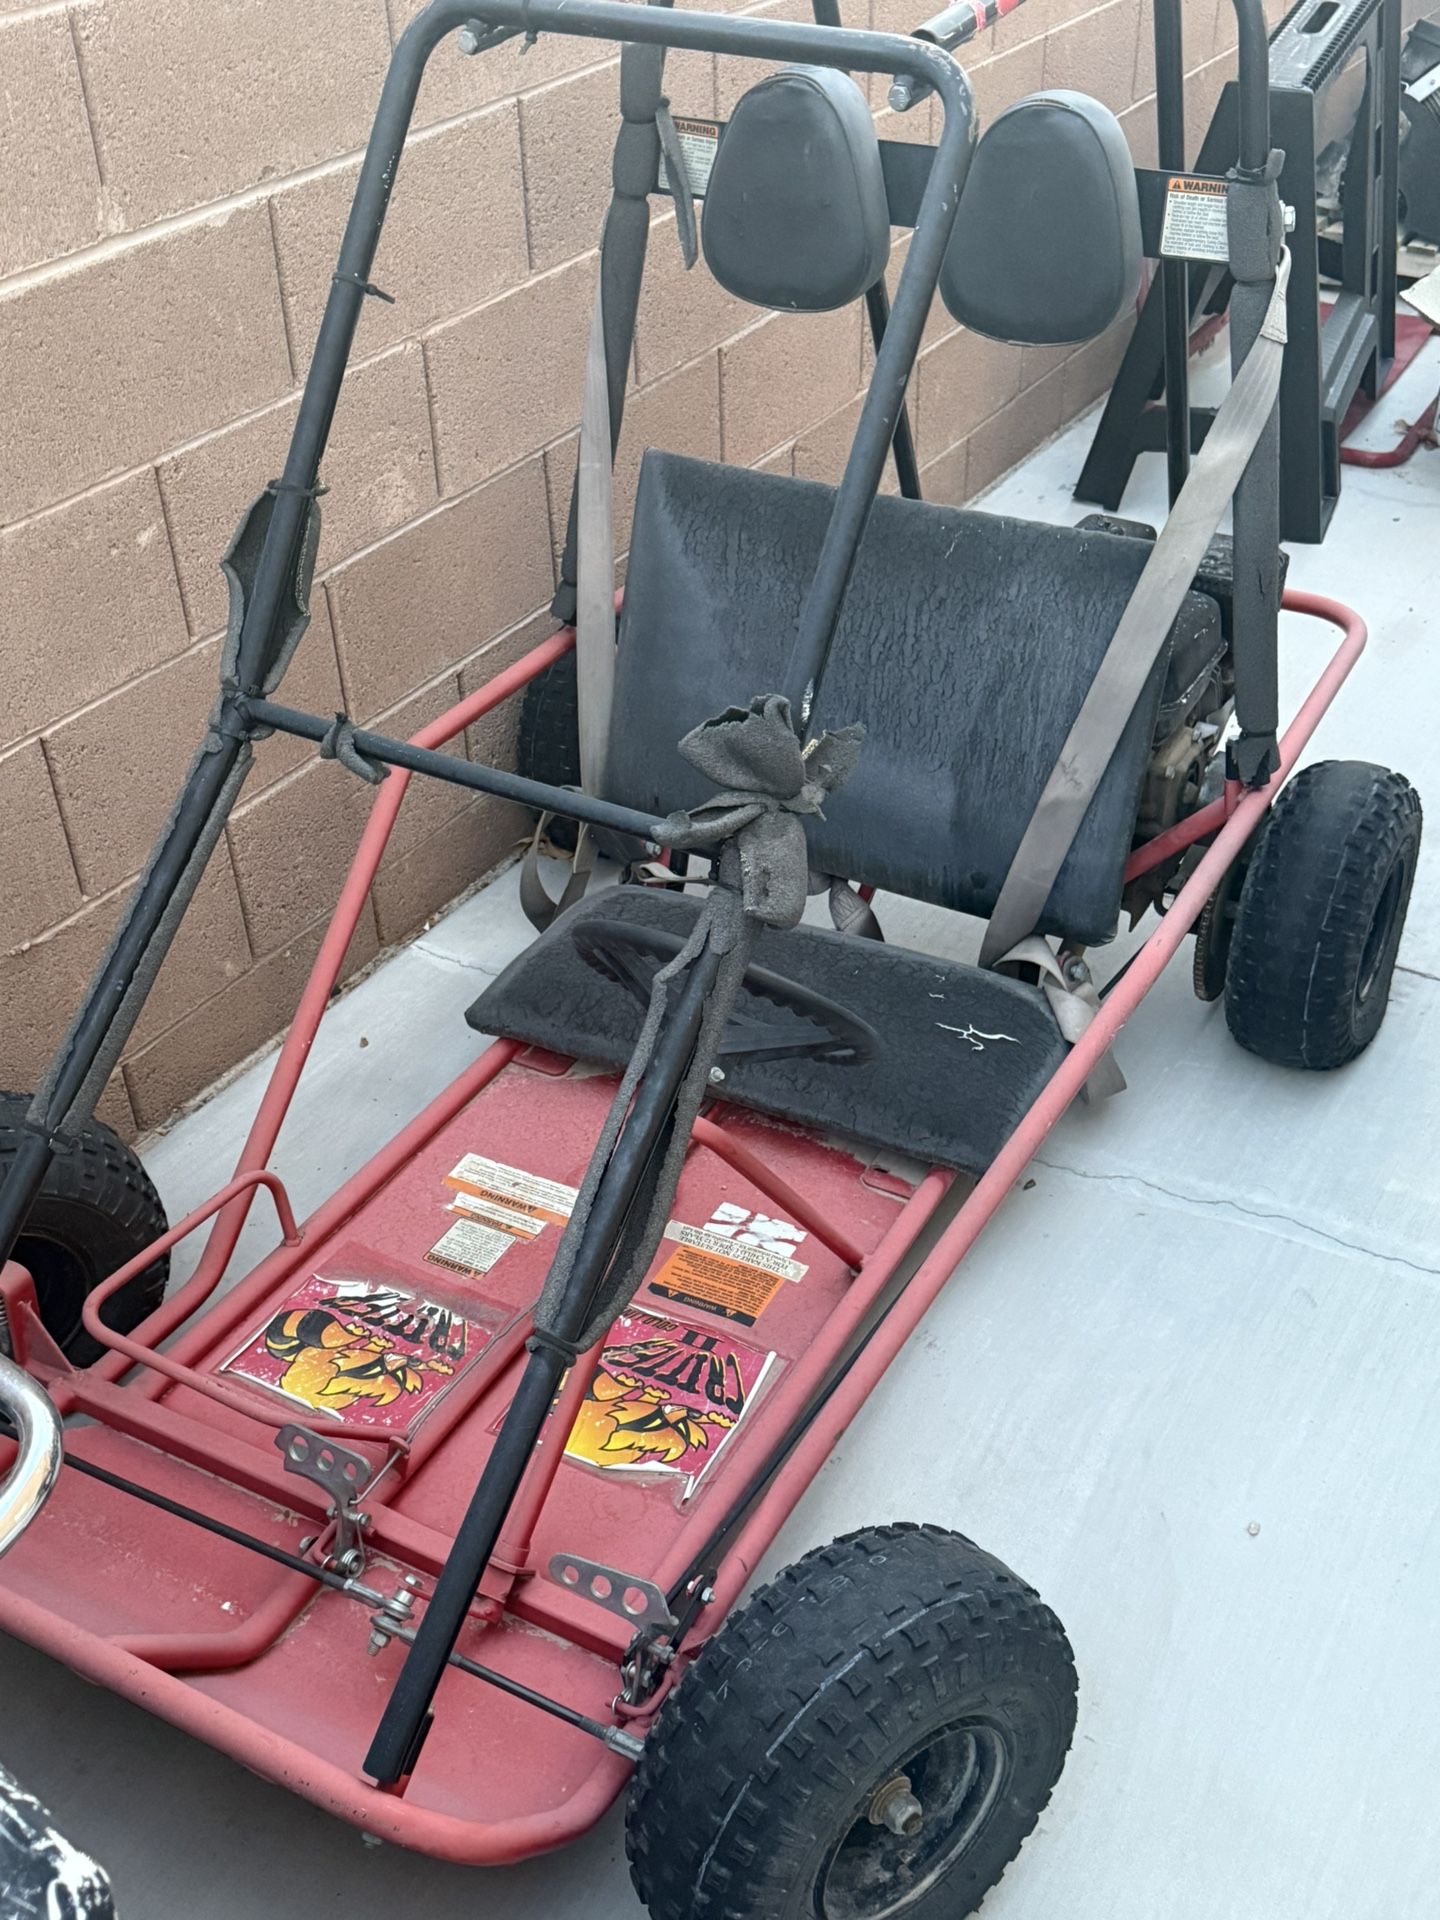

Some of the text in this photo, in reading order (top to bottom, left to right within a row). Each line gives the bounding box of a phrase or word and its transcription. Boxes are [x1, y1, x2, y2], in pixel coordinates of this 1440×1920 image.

[1183, 180, 1229, 194] WARNIN
[480, 1190, 528, 1210] WARNING
[680, 1230, 703, 1241] YEARS
[714, 1247, 731, 1256] NOT
[739, 1249, 764, 1261] CHILD
[427, 1255, 471, 1275] WARNING
[761, 1262, 780, 1272] THIS
[772, 1259, 788, 1270] FOR
[683, 1296, 717, 1312] WARNING
[623, 1307, 678, 1331] GOLD LIN
[676, 1328, 725, 1354] II
